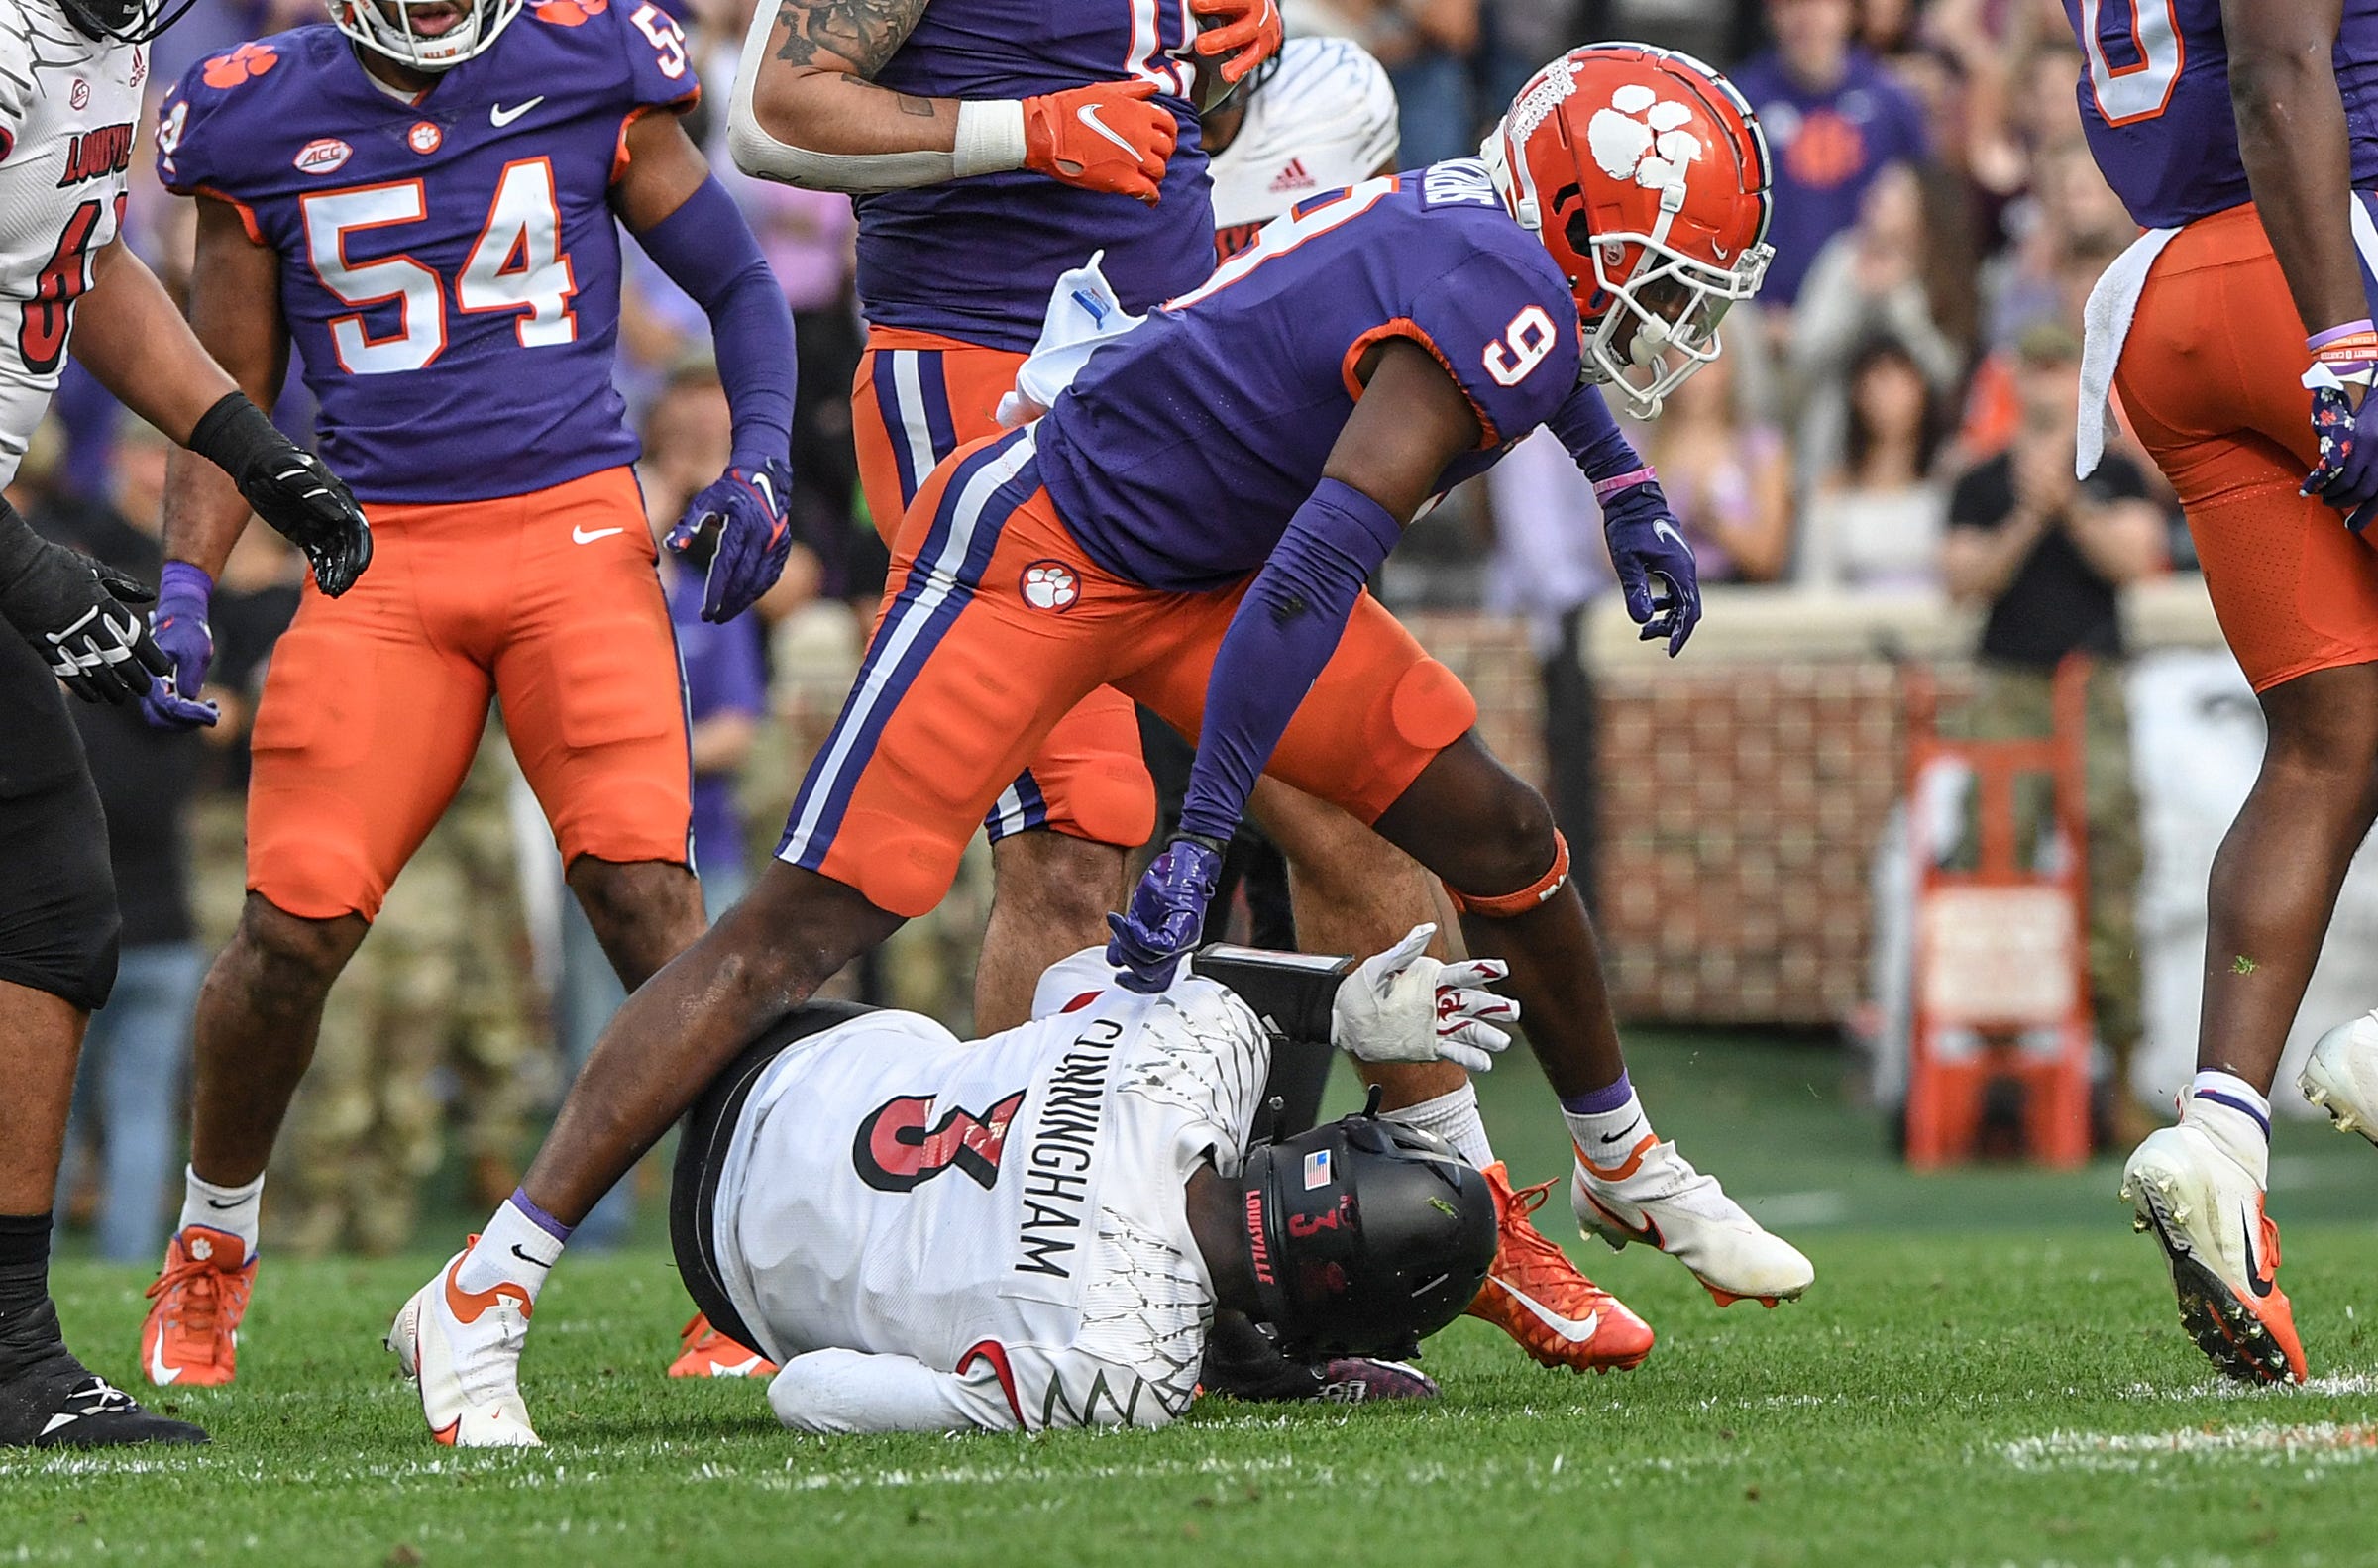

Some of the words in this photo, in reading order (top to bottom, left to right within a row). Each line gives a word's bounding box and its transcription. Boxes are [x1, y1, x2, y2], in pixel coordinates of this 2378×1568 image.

[628, 1, 686, 81] 5
[302, 146, 342, 164] ACC
[18, 191, 128, 375] 6
[299, 156, 579, 374] 54
[1481, 304, 1558, 388] 9
[852, 1086, 1027, 1193] 3
[1015, 1019, 1123, 1279] CUNNINGHAM
[1245, 1189, 1276, 1285] LOUISVILLE
[1289, 1208, 1338, 1238] 3
